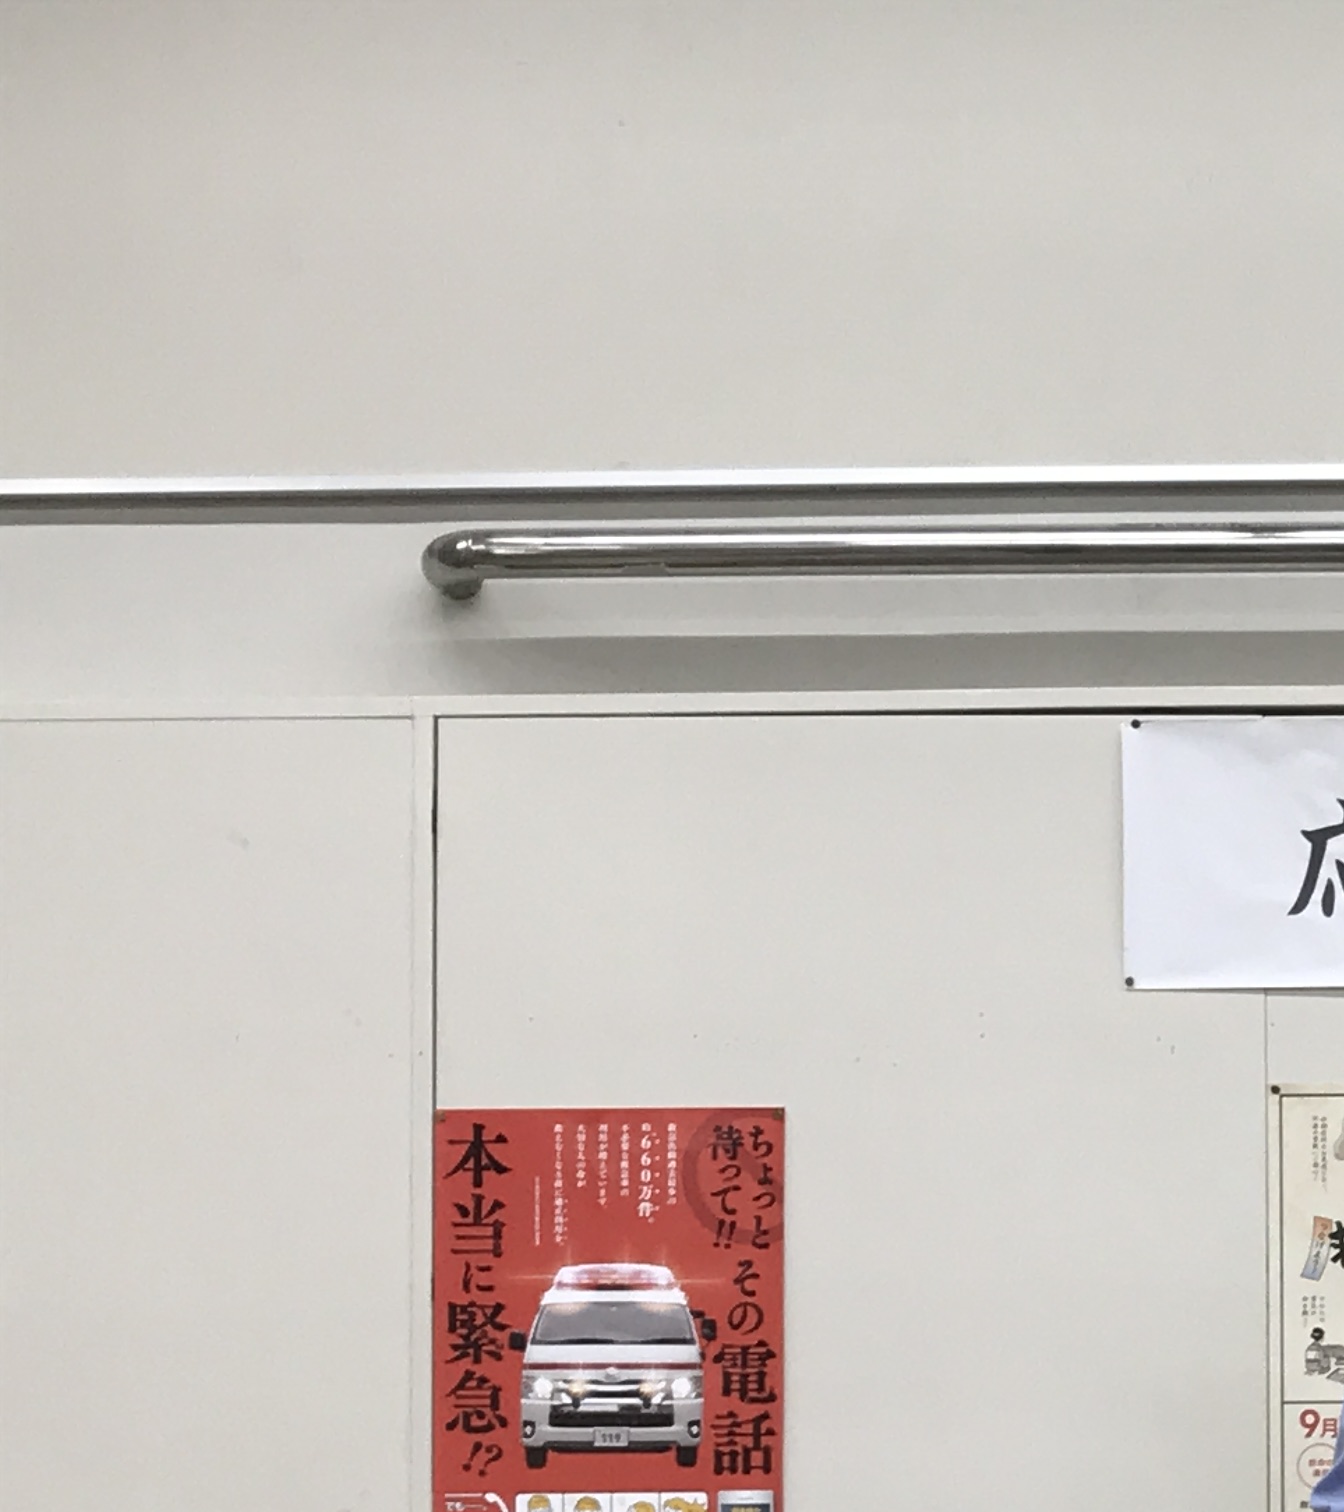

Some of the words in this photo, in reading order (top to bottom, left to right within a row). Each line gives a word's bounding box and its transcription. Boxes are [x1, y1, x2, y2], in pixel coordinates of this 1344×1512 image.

[747, 1125, 776, 1249] ちょっと
[710, 1259, 778, 1476] その電話
